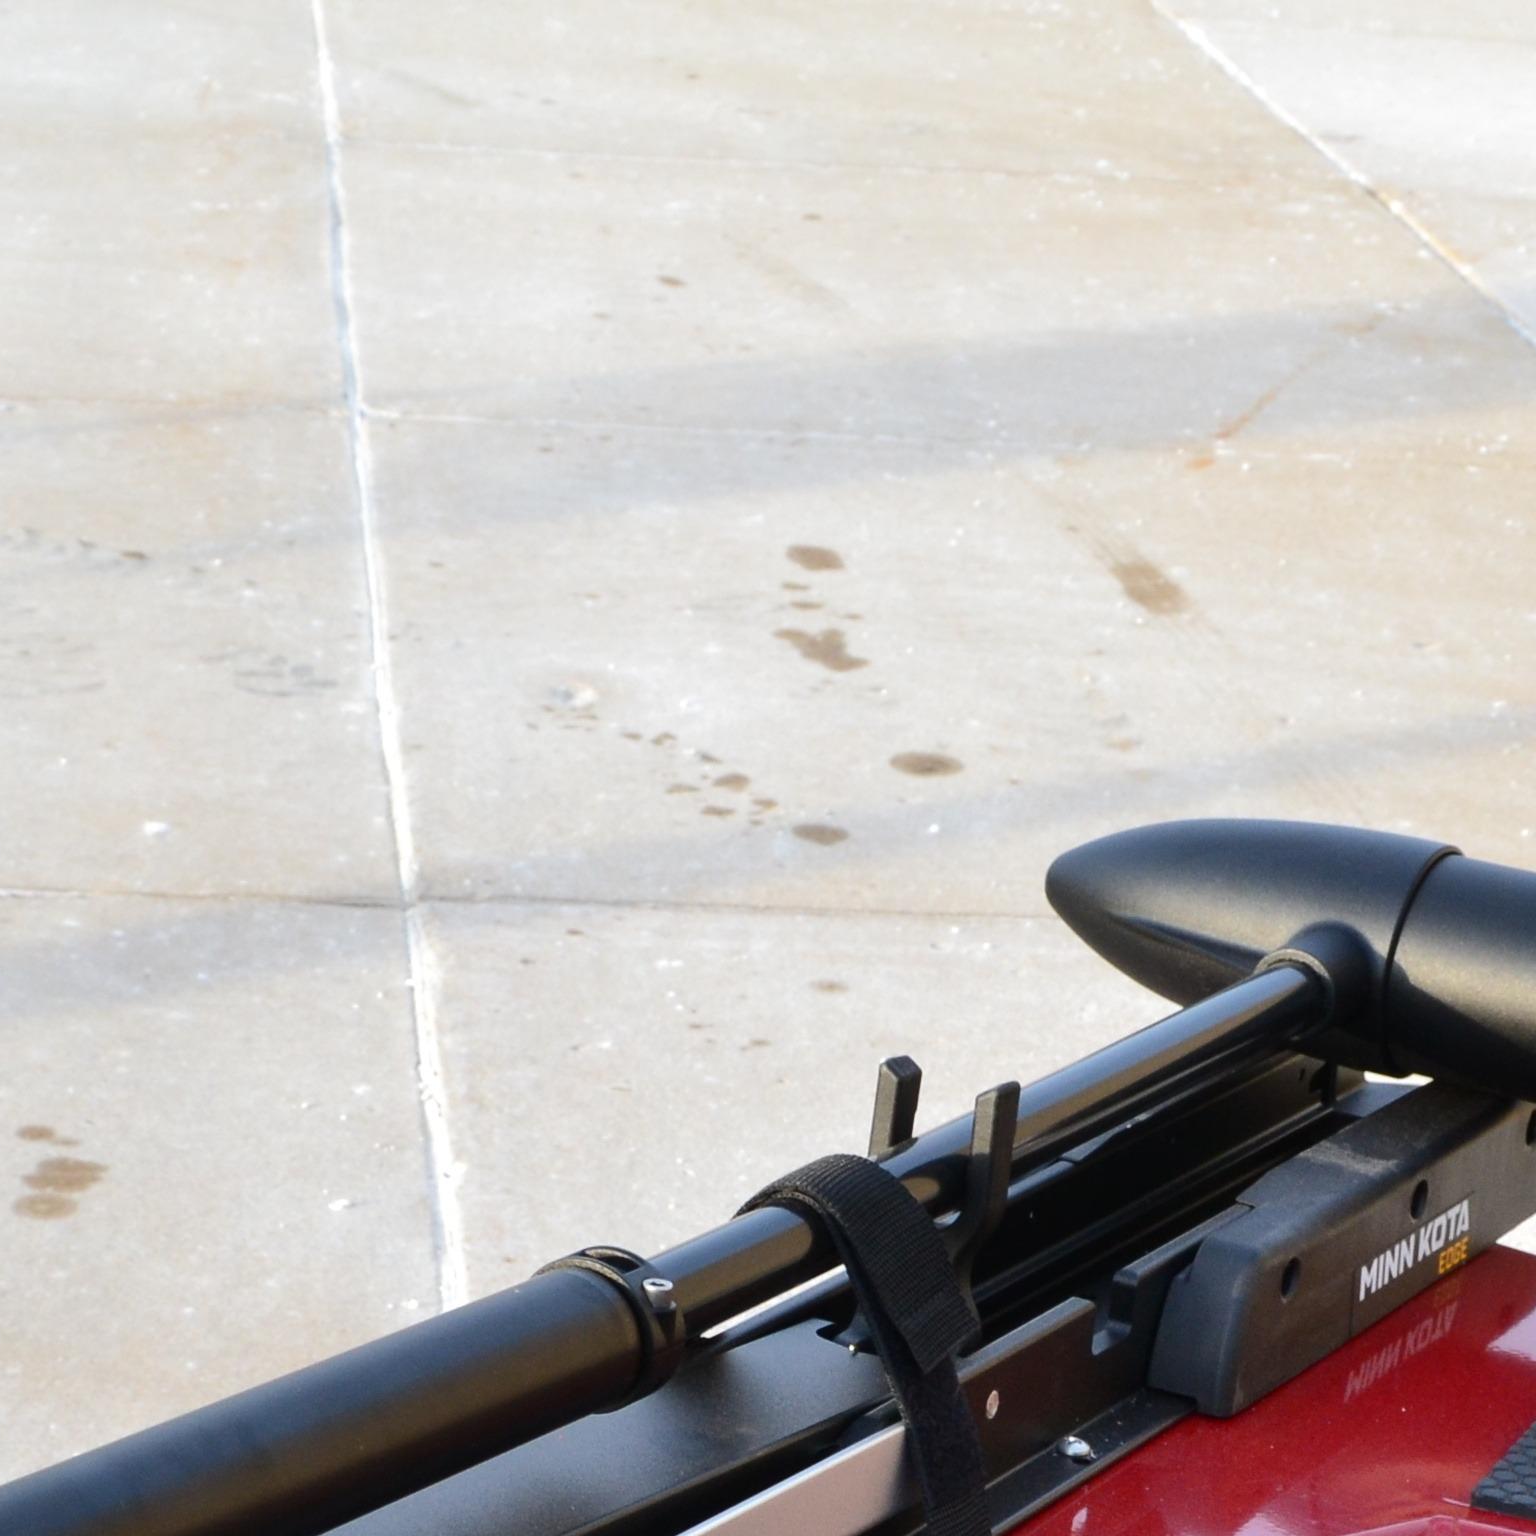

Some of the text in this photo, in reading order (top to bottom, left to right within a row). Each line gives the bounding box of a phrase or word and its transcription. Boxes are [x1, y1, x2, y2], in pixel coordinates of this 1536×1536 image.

[1359, 1233, 1415, 1302] MINN
[1417, 1199, 1470, 1263] KOTA
[1438, 1235, 1471, 1275] EDGE
